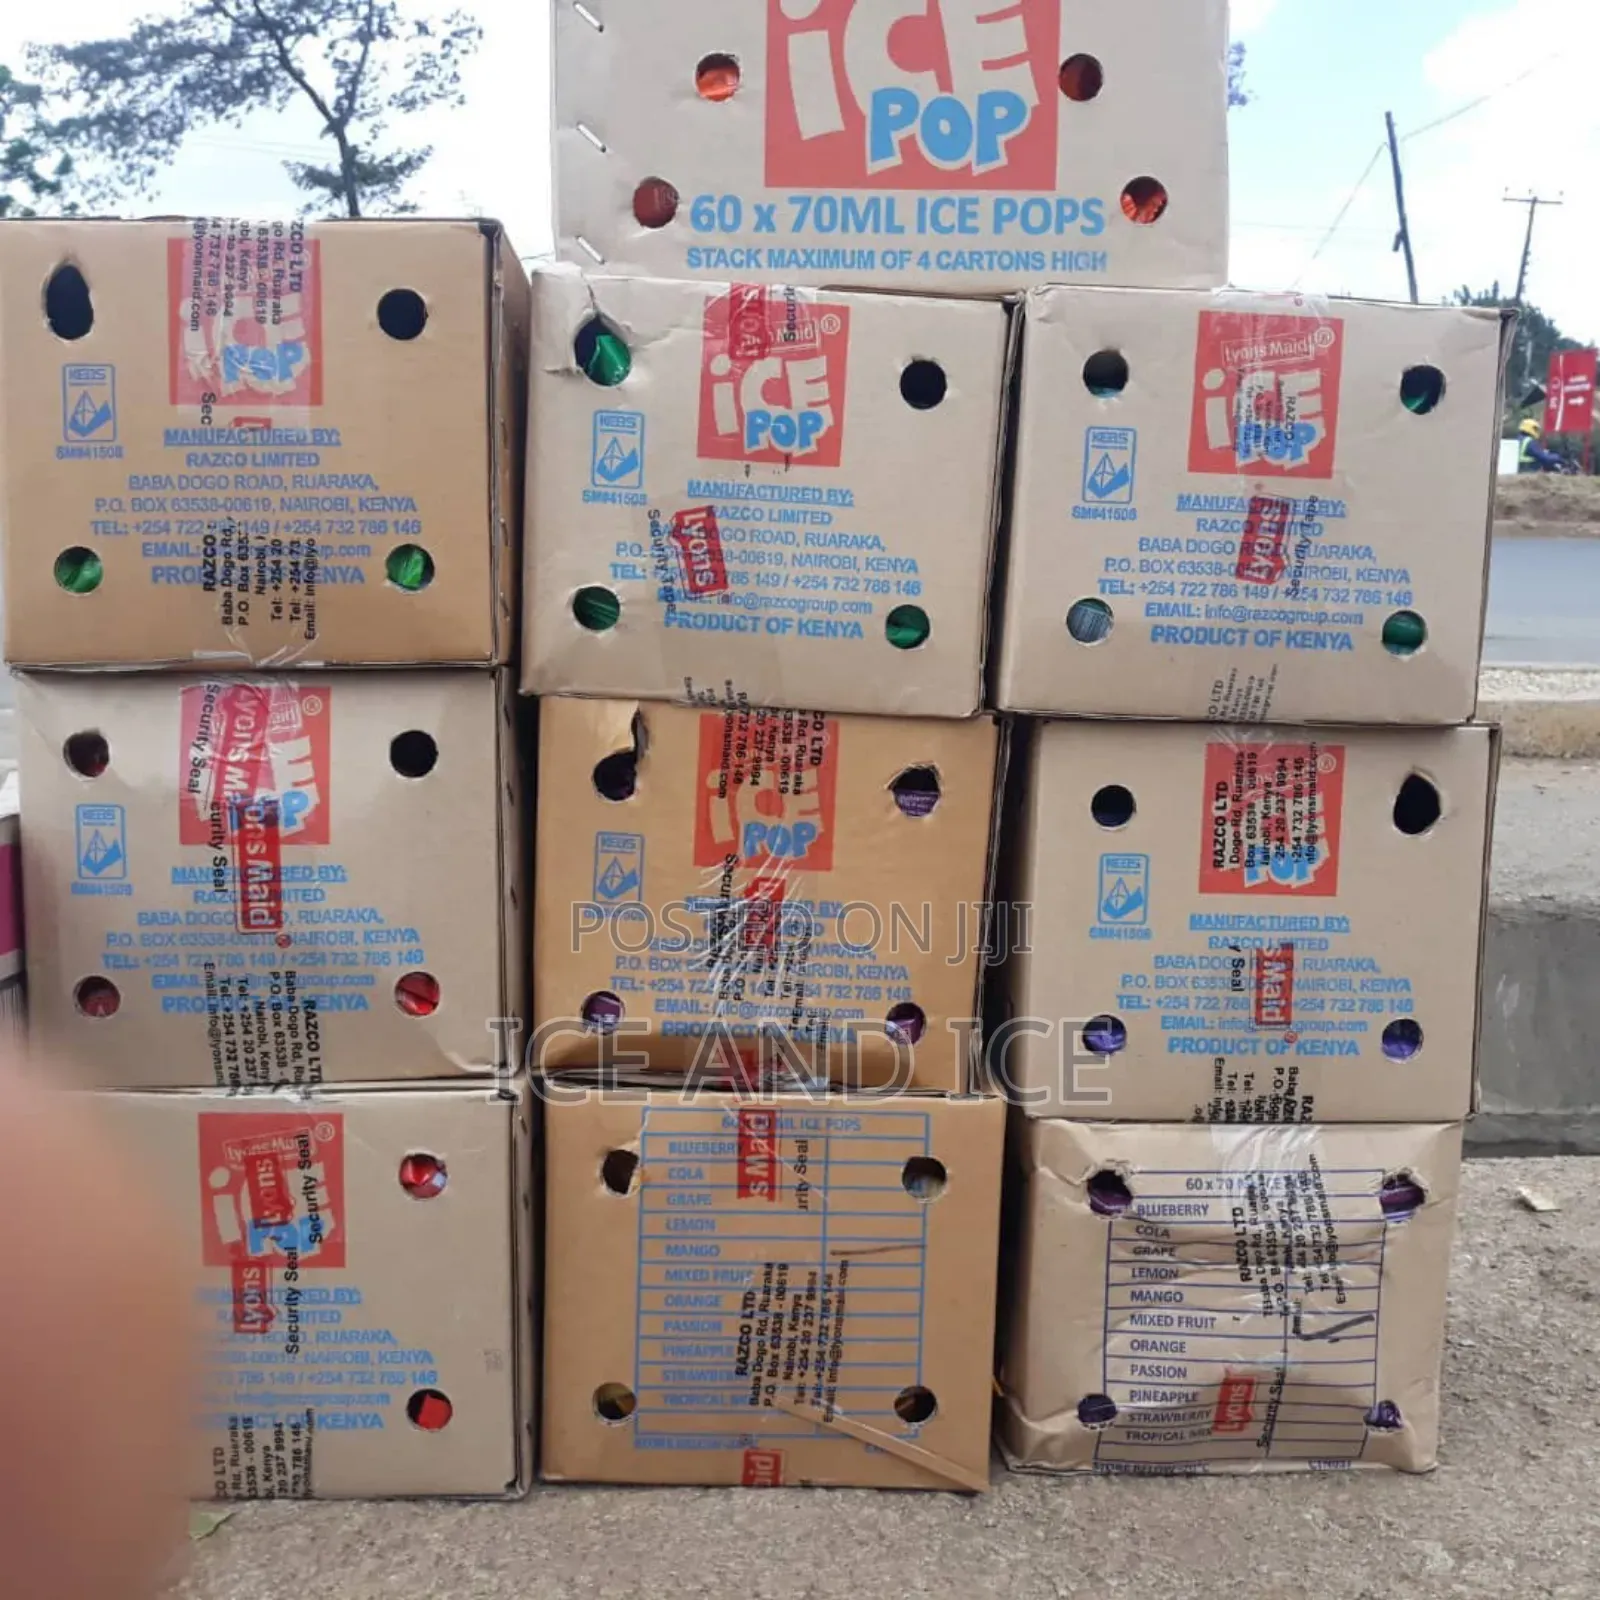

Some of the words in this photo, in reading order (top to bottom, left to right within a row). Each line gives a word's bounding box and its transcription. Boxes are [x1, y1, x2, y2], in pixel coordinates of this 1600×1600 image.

[868, 87, 1029, 176] POP
[689, 196, 741, 235] 60
[753, 202, 776, 232] x
[790, 196, 905, 235] 70ML
[917, 198, 978, 235] ICE
[994, 197, 1104, 236] POPS
[687, 249, 760, 270] STACK
[766, 249, 875, 270] MAXIMUM
[880, 250, 911, 270] OF
[917, 250, 930, 270] 4
[935, 250, 1044, 272] CARTONS
[1051, 252, 1107, 272] HIGH
[164, 428, 307, 446] MANUFACTURED
[312, 429, 340, 446] BY:
[746, 410, 822, 449] POP
[186, 453, 247, 467] RAZCO
[251, 453, 320, 467] LIMITED
[129, 475, 175, 490] BABA
[178, 475, 229, 490] DOGO
[235, 475, 288, 492] ROAD,
[292, 475, 378, 490] RUARAKA,
[688, 480, 823, 504] MANUFACTURED
[827, 489, 854, 506] BY:
[95, 498, 124, 512] P.O.
[131, 498, 167, 512] BOX
[281, 497, 354, 512] NAIROBI,
[359, 497, 417, 511] KENYA
[769, 507, 833, 525] LIMITED
[91, 521, 129, 535] TEL:
[132, 521, 170, 535] +254
[284, 520, 320, 534] +254
[326, 520, 354, 534] 732
[393, 520, 421, 534] 146
[751, 529, 799, 546] ROAD,
[804, 532, 886, 550] RUARAKA,
[1139, 538, 1182, 553] BABA
[1187, 540, 1235, 555] DOGO
[203, 535, 216, 591] RAZCO
[616, 543, 645, 557] P.O.
[791, 555, 861, 572] NAIROBI,
[865, 556, 917, 573] KENYA
[610, 564, 647, 580] TEL:
[755, 573, 779, 586] 149
[792, 575, 827, 590] +254
[833, 578, 859, 593] 732
[863, 579, 889, 594] 786
[896, 581, 921, 595] 146
[1105, 558, 1134, 573] P.O.
[1140, 559, 1174, 574] BOX
[1357, 569, 1410, 583] KENYA
[1099, 579, 1134, 594] TEL:
[1139, 580, 1175, 596] +254
[1179, 582, 1207, 596] 722
[1211, 583, 1238, 598] 786
[1244, 584, 1269, 598] 149
[1324, 589, 1349, 602] 732
[1355, 589, 1381, 604] 786
[1387, 592, 1412, 606] 146
[222, 596, 233, 625] Baba
[305, 598, 315, 640] Email:
[1146, 603, 1200, 618] EMAIL:
[1205, 605, 1363, 625] info@razcogroup.com
[665, 611, 760, 633] PRODUCT
[766, 615, 792, 634] OF
[799, 617, 863, 638] KENYA
[1151, 626, 1249, 646] PRODUCT
[1257, 629, 1281, 647] OF
[1286, 630, 1353, 650] KENYA
[194, 684, 221, 751] Security
[188, 756, 207, 794] Seal
[1215, 781, 1229, 811] LTD
[1213, 815, 1226, 869] RAZCO
[213, 857, 228, 892] Seal
[247, 859, 273, 928] Maid
[138, 912, 181, 925] BABA
[186, 911, 236, 925] DOGO
[298, 910, 382, 925] RUARAKA,
[1190, 914, 1318, 932] MANUFACTURED
[107, 933, 135, 946] P.O.
[142, 932, 175, 946] BOX
[364, 929, 419, 944] KENYA
[1209, 936, 1263, 950] RAZCO
[103, 955, 139, 968] TEL:
[290, 952, 327, 967] +254
[331, 952, 358, 966] 732
[616, 957, 645, 971] P.O.
[650, 958, 681, 973] BOX
[856, 966, 908, 980] KENYA
[1154, 956, 1195, 970] BABA
[1303, 957, 1380, 973] RUARAKA,
[1121, 975, 1151, 989] P.O.
[1155, 976, 1188, 990] BOX
[1360, 978, 1410, 993] KENYA
[1232, 959, 1245, 991] Seal
[611, 977, 644, 992] TEL:
[825, 984, 852, 998] 732
[1261, 961, 1285, 1023] Maid
[655, 999, 708, 1015] EMAIL:
[1116, 995, 1150, 1010] TEL:
[1156, 996, 1188, 1010] +254
[1194, 996, 1219, 1010] 722
[1329, 999, 1355, 1013] 732
[1161, 1015, 1215, 1030] EMAIL:
[1169, 1037, 1260, 1055] PRODUCT
[1265, 1039, 1292, 1055] OF
[1297, 1039, 1358, 1056] KENYA
[826, 1119, 861, 1131] POPS
[297, 1132, 312, 1171] Seal
[795, 1139, 809, 1175] Seal
[668, 1167, 704, 1180] COLA
[1186, 1179, 1203, 1191] 60
[1217, 1179, 1233, 1191] 70
[667, 1193, 712, 1205] GRAPE
[301, 1174, 323, 1244] Security
[1137, 1204, 1209, 1217] BLUEBERRY
[666, 1218, 715, 1231] LEMON
[1136, 1225, 1170, 1239] COLA
[665, 1244, 720, 1256] MANGO
[1133, 1246, 1176, 1257] GRAPE
[284, 1246, 298, 1282] Seal
[665, 1269, 709, 1282] MIXED
[1131, 1267, 1179, 1280] LEMON
[664, 1294, 723, 1307] ORANGE
[743, 1291, 756, 1318] LTD
[1130, 1291, 1184, 1304] MANGO
[285, 1284, 299, 1355] Security
[664, 1320, 723, 1333] PASSION
[1129, 1314, 1173, 1327] MIXED
[1177, 1316, 1216, 1329] FRUIT
[316, 1330, 397, 1344] RUARAKA,
[1130, 1339, 1186, 1353] ORANGE
[378, 1350, 434, 1364] KENYA
[736, 1323, 752, 1376] RAZCO
[1130, 1365, 1187, 1378] PASSION
[1129, 1390, 1199, 1403] PINEAPPLE
[317, 1413, 383, 1429] KENYA
[1128, 1409, 1211, 1423] STRAWBERRY
[1126, 1428, 1186, 1441] TROPICAL
[213, 1447, 226, 1476] LTD
